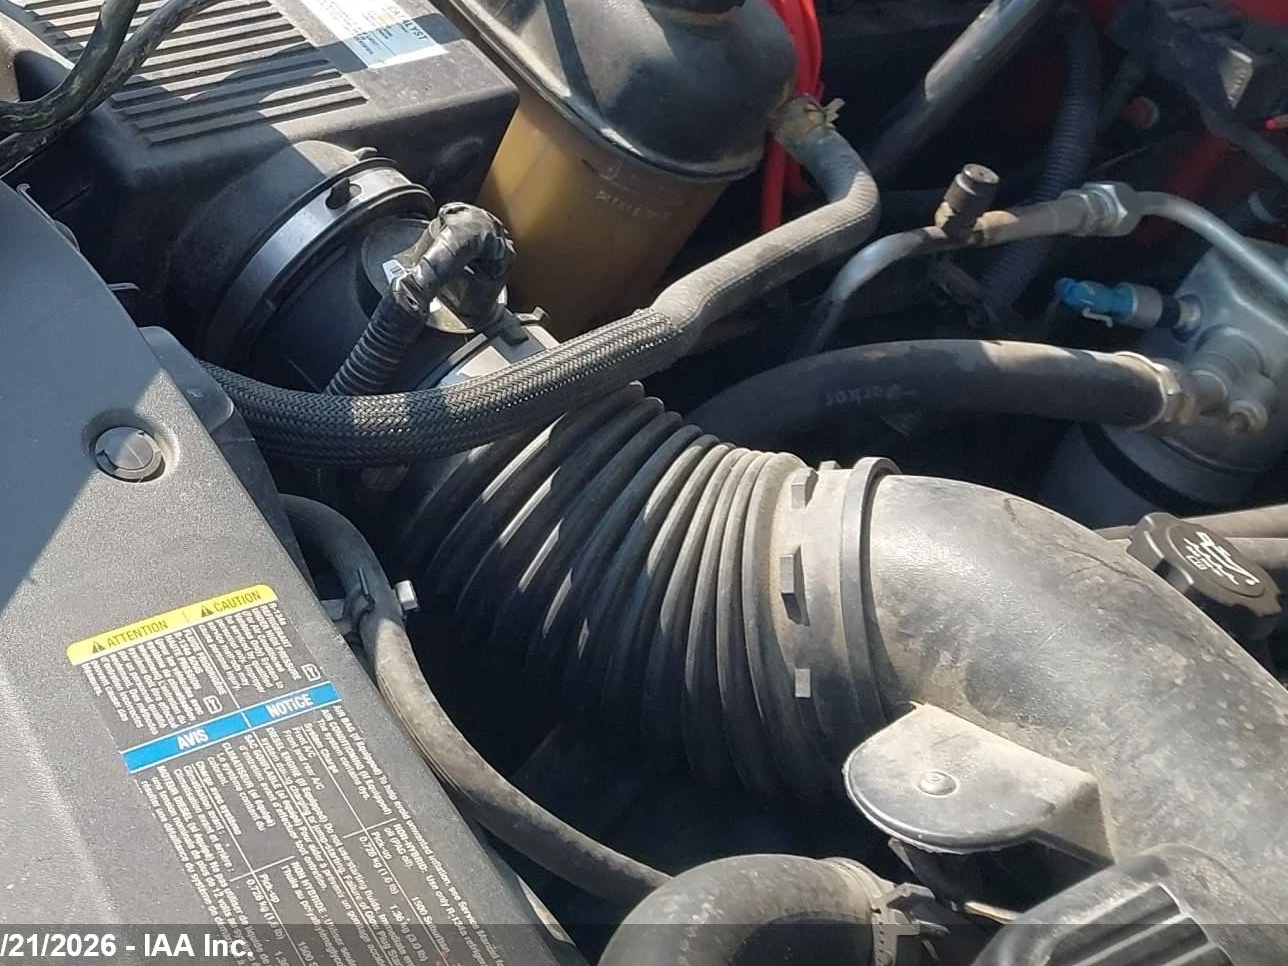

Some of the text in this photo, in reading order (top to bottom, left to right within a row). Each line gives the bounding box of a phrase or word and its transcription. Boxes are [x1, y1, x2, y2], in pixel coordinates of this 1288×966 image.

[213, 590, 262, 612] CAUTION
[258, 604, 293, 648] REFRIGERANT
[267, 601, 287, 626] R-134a
[106, 620, 170, 647] ATTENTION
[163, 633, 202, 690] HAUTE PRESSION
[172, 630, 204, 674] R-134a SOUS
[181, 627, 202, 653] FLUIDE
[197, 623, 214, 644] cause
[207, 642, 231, 671] personal
[229, 623, 252, 652] serviced
[232, 611, 254, 640] Vehicles
[259, 655, 280, 681] System
[250, 606, 302, 681] UNDER HIGH PRESSURE
[242, 663, 266, 693] Improper
[265, 692, 315, 718] NOTICE
[176, 729, 210, 751] AVIS
[281, 728, 299, 748] Front
[301, 761, 316, 776] rear
[290, 725, 309, 745] Front
[172, 767, 203, 814] Climatisation
[196, 812, 215, 834] avant
[181, 764, 212, 810] Climatisation
[206, 808, 225, 831] avant
[206, 755, 229, 787] colorant.
[220, 761, 243, 792] système
[237, 790, 261, 821] contient
[323, 731, 344, 757] system
[338, 755, 362, 786] contains
[357, 784, 370, 801] dye.
[388, 836, 407, 855] (PAG
[194, 759, 280, 903] Charge avec système Pick-up
[221, 741, 255, 789] CLIMATISEUR
[300, 878, 327, 914] HYBRIDE
[251, 748, 283, 790] GONFLABLE
[297, 825, 313, 843] Pour
[307, 842, 324, 862] aider
[259, 781, 278, 802] avant
[293, 838, 309, 856] tout
[302, 721, 324, 749] System
[319, 747, 340, 774] Charge
[369, 830, 392, 860] Pick-up
[410, 895, 428, 916] 1500
[328, 720, 365, 771] CONDITIONING
[363, 778, 393, 815] Equipped)
[434, 889, 451, 907] only
[354, 740, 383, 776] Equipped)
[382, 783, 398, 801] help
[392, 799, 411, 820] avoid
[404, 819, 434, 855] unwanted
[456, 900, 477, 926] Service
[155, 764, 180, 796] MOTEUR
[172, 794, 193, 823] DIESEL
[222, 886, 243, 914] utiliser
[157, 789, 178, 817] tension
[171, 815, 196, 850] nominale
[194, 859, 211, 877] plus
[216, 897, 232, 917] volts
[260, 736, 280, 762] system
[286, 784, 312, 817] charging
[342, 873, 363, 901] Failure
[374, 929, 392, 950] Plug
[264, 725, 285, 752] DIESEL
[279, 750, 302, 778] ENGINE
[300, 786, 329, 823] Equipped)
[345, 860, 368, 890] starting
[376, 912, 406, 954] Immediate
